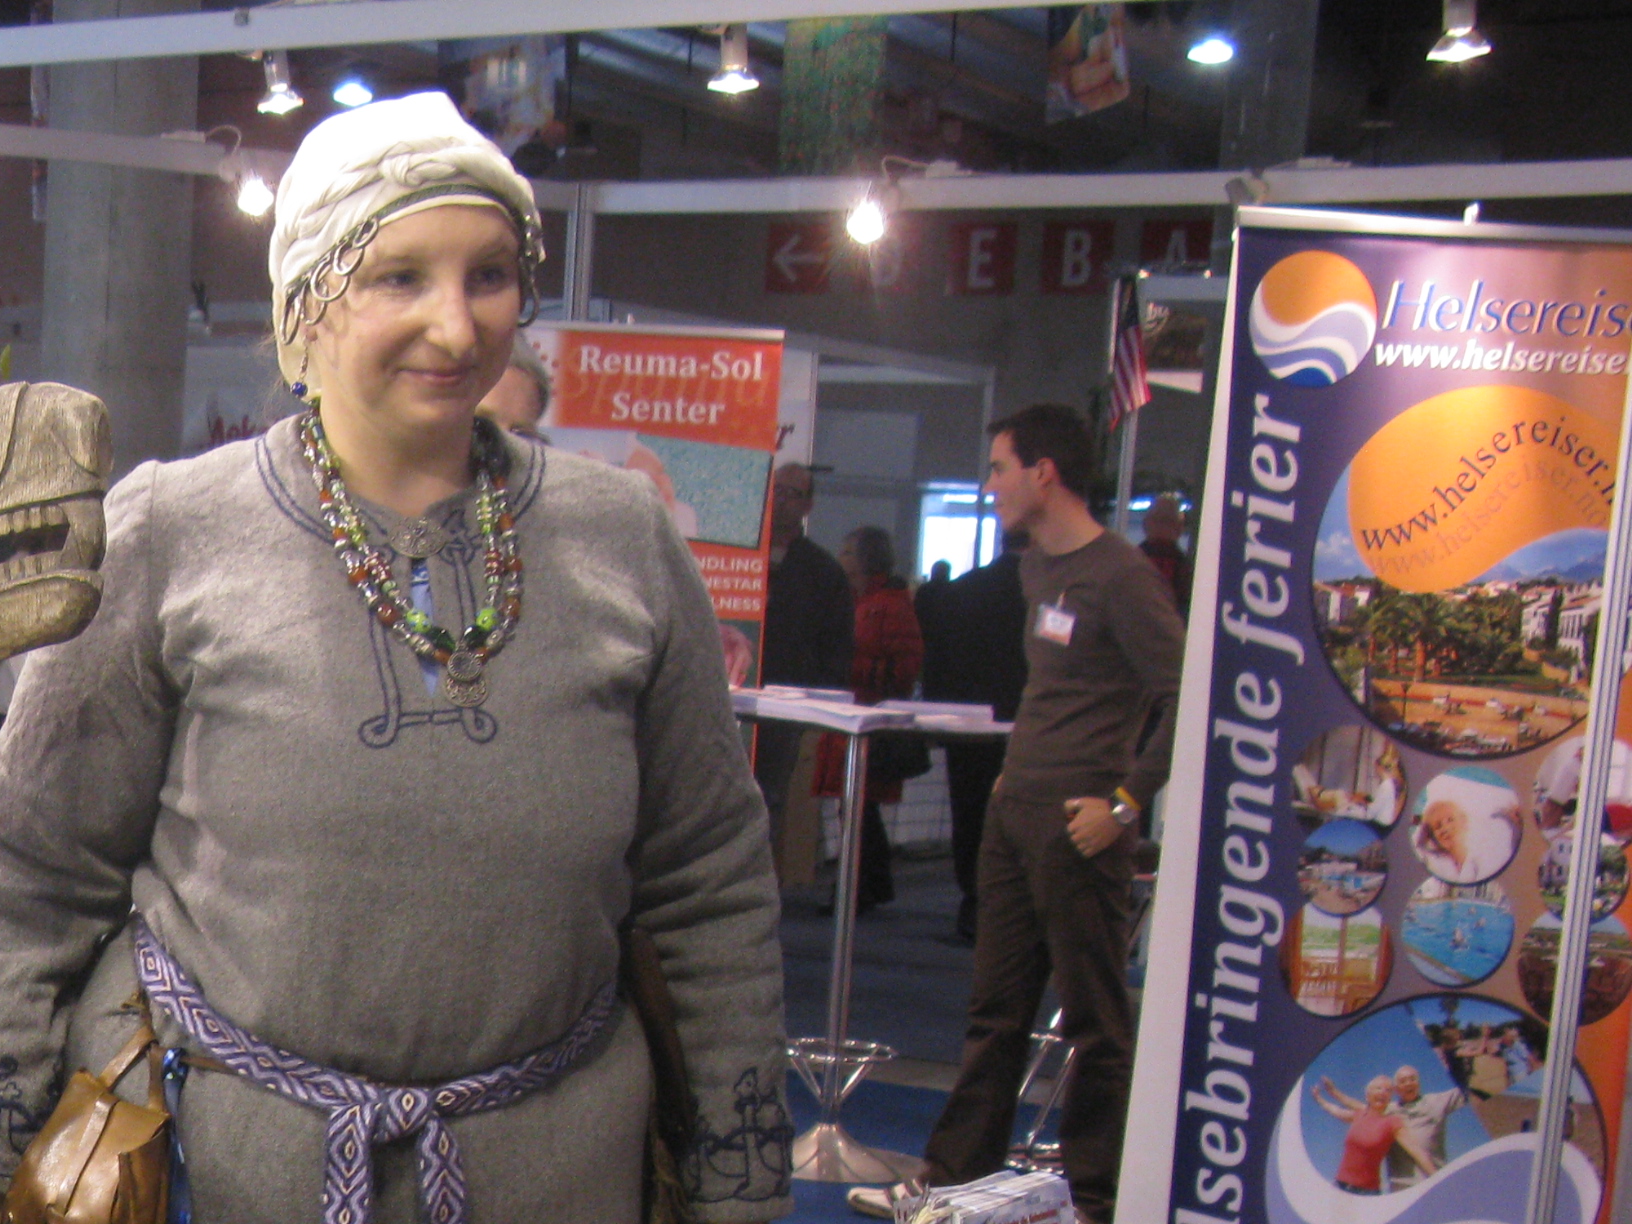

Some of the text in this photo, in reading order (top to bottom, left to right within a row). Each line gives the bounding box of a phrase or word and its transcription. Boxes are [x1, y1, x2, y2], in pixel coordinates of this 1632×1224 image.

[968, 228, 999, 289] E
[1061, 228, 1092, 287] B
[1382, 279, 1632, 339] Helsereis
[579, 344, 763, 381] Reuma-Sol
[611, 391, 726, 425] Senter
[1222, 394, 1305, 666] ferier
